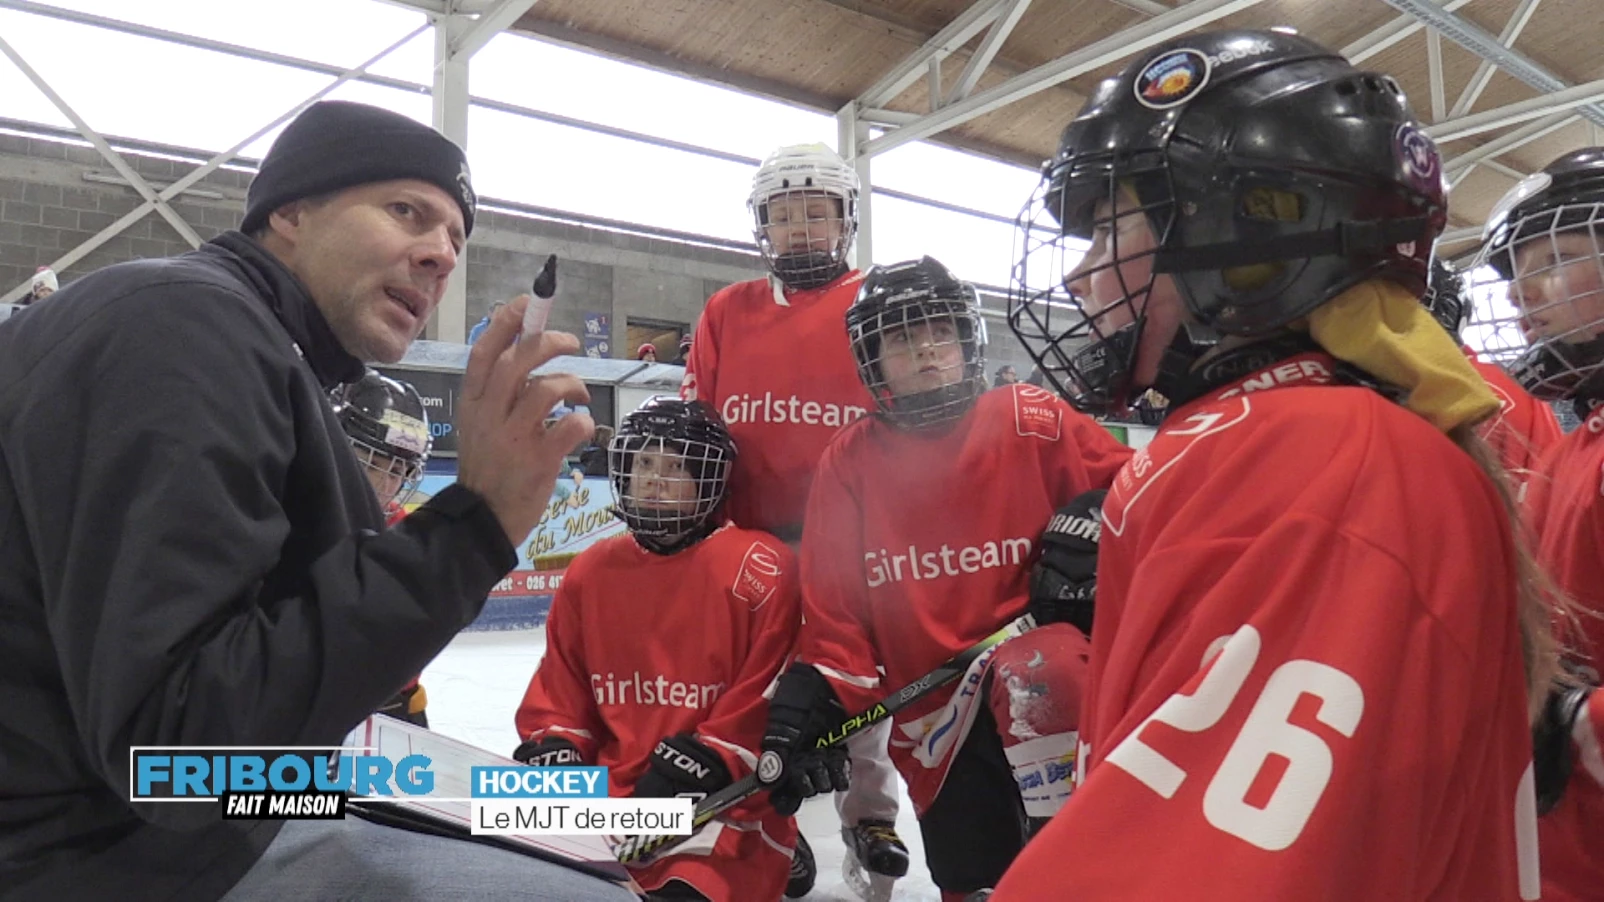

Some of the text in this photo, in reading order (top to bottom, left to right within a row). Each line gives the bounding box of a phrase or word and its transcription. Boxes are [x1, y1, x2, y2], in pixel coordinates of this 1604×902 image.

[1023, 406, 1055, 418] SWISS
[526, 526, 556, 560] du
[864, 536, 1033, 588] Girlsteam
[491, 577, 513, 593] ret
[526, 575, 545, 591] 026
[815, 703, 888, 749] ALPHA
[1104, 623, 1365, 851] 26
